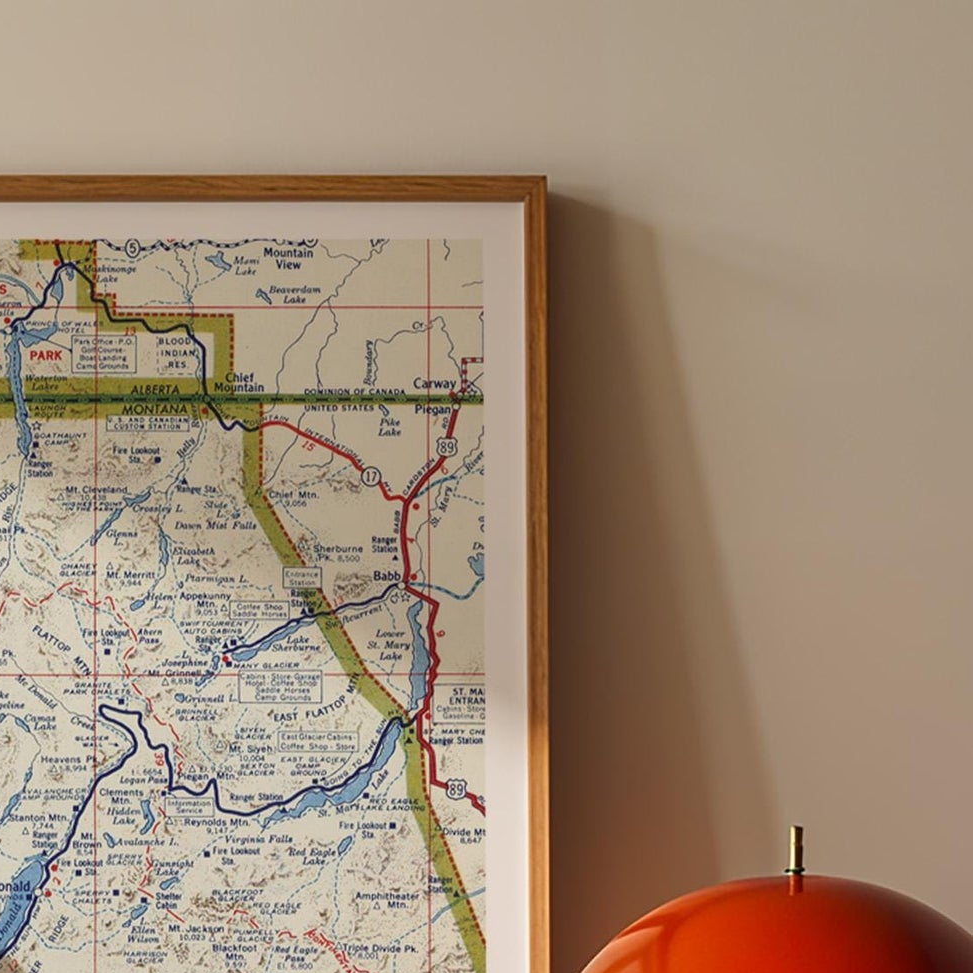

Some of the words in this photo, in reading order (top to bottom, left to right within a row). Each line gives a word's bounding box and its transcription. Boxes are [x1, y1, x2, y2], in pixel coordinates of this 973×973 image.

[129, 242, 136, 254] 5
[264, 248, 313, 258] Mountain
[276, 260, 301, 269] View
[235, 267, 256, 275] Lake
[269, 286, 321, 294] Beaverdam
[30, 351, 62, 360] PARK
[364, 340, 373, 386] Boundary
[226, 373, 253, 382] Chief
[214, 383, 264, 392] Mountain
[413, 378, 456, 389] Carway
[131, 386, 179, 394] ALBERTA
[122, 405, 187, 414] MONTANA
[415, 405, 450, 414] Piegan
[440, 442, 454, 453] 89
[366, 471, 376, 482] 17
[374, 572, 400, 580] Babb
[180, 592, 231, 600] Appekunny
[385, 642, 410, 650] Mary
[274, 712, 298, 721] EAST
[306, 695, 345, 718] FLATTOP
[450, 784, 463, 794] 89
[185, 819, 226, 827] Reynolds
[310, 849, 335, 857] Eagle
[356, 893, 419, 901] Amphitheater
[343, 944, 369, 952] Triple
